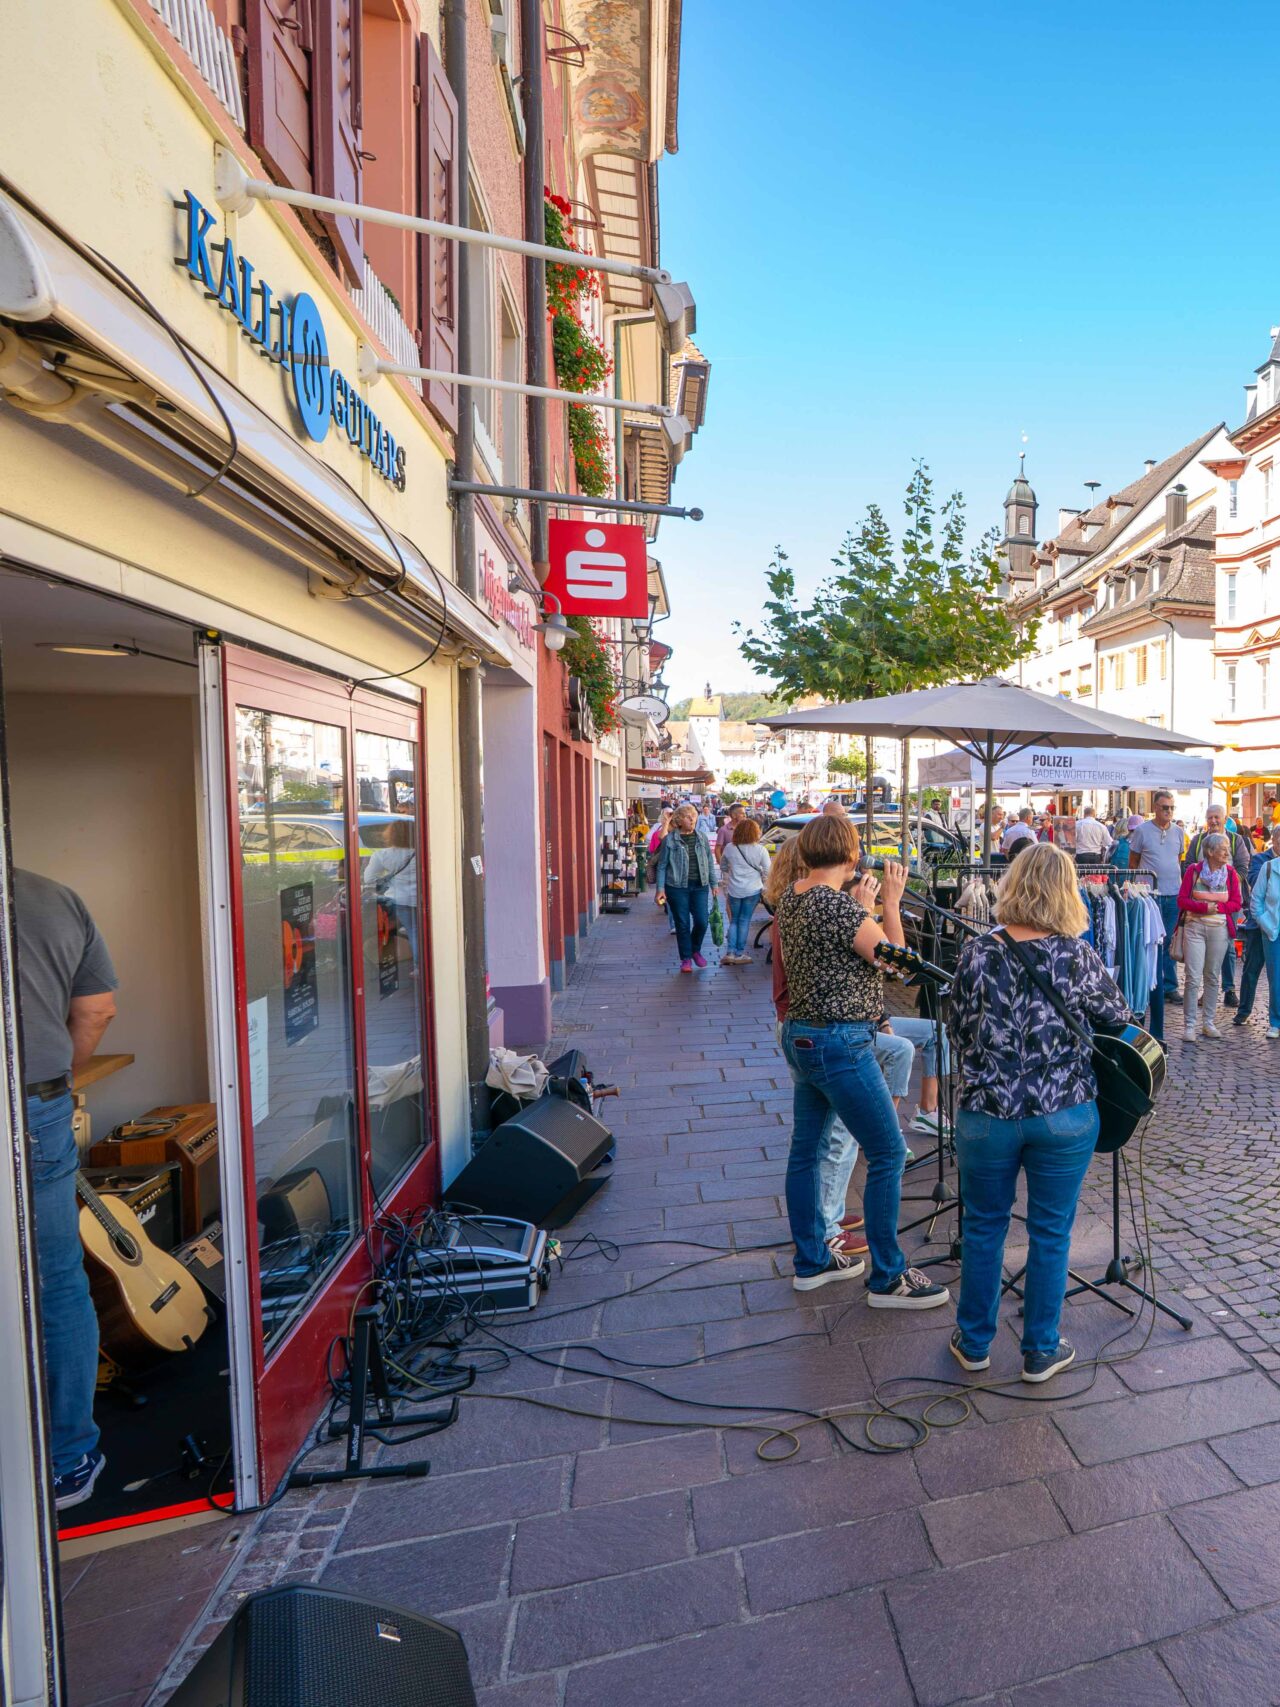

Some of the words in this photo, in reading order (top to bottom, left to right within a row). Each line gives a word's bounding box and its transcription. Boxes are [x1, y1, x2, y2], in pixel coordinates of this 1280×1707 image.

[184, 190, 292, 372] KALLI
[330, 369, 405, 492] GUITARS
[1031, 768, 1127, 782] BADEN-WÜRTTEMBERG
[1032, 754, 1073, 768] POLIZEI
